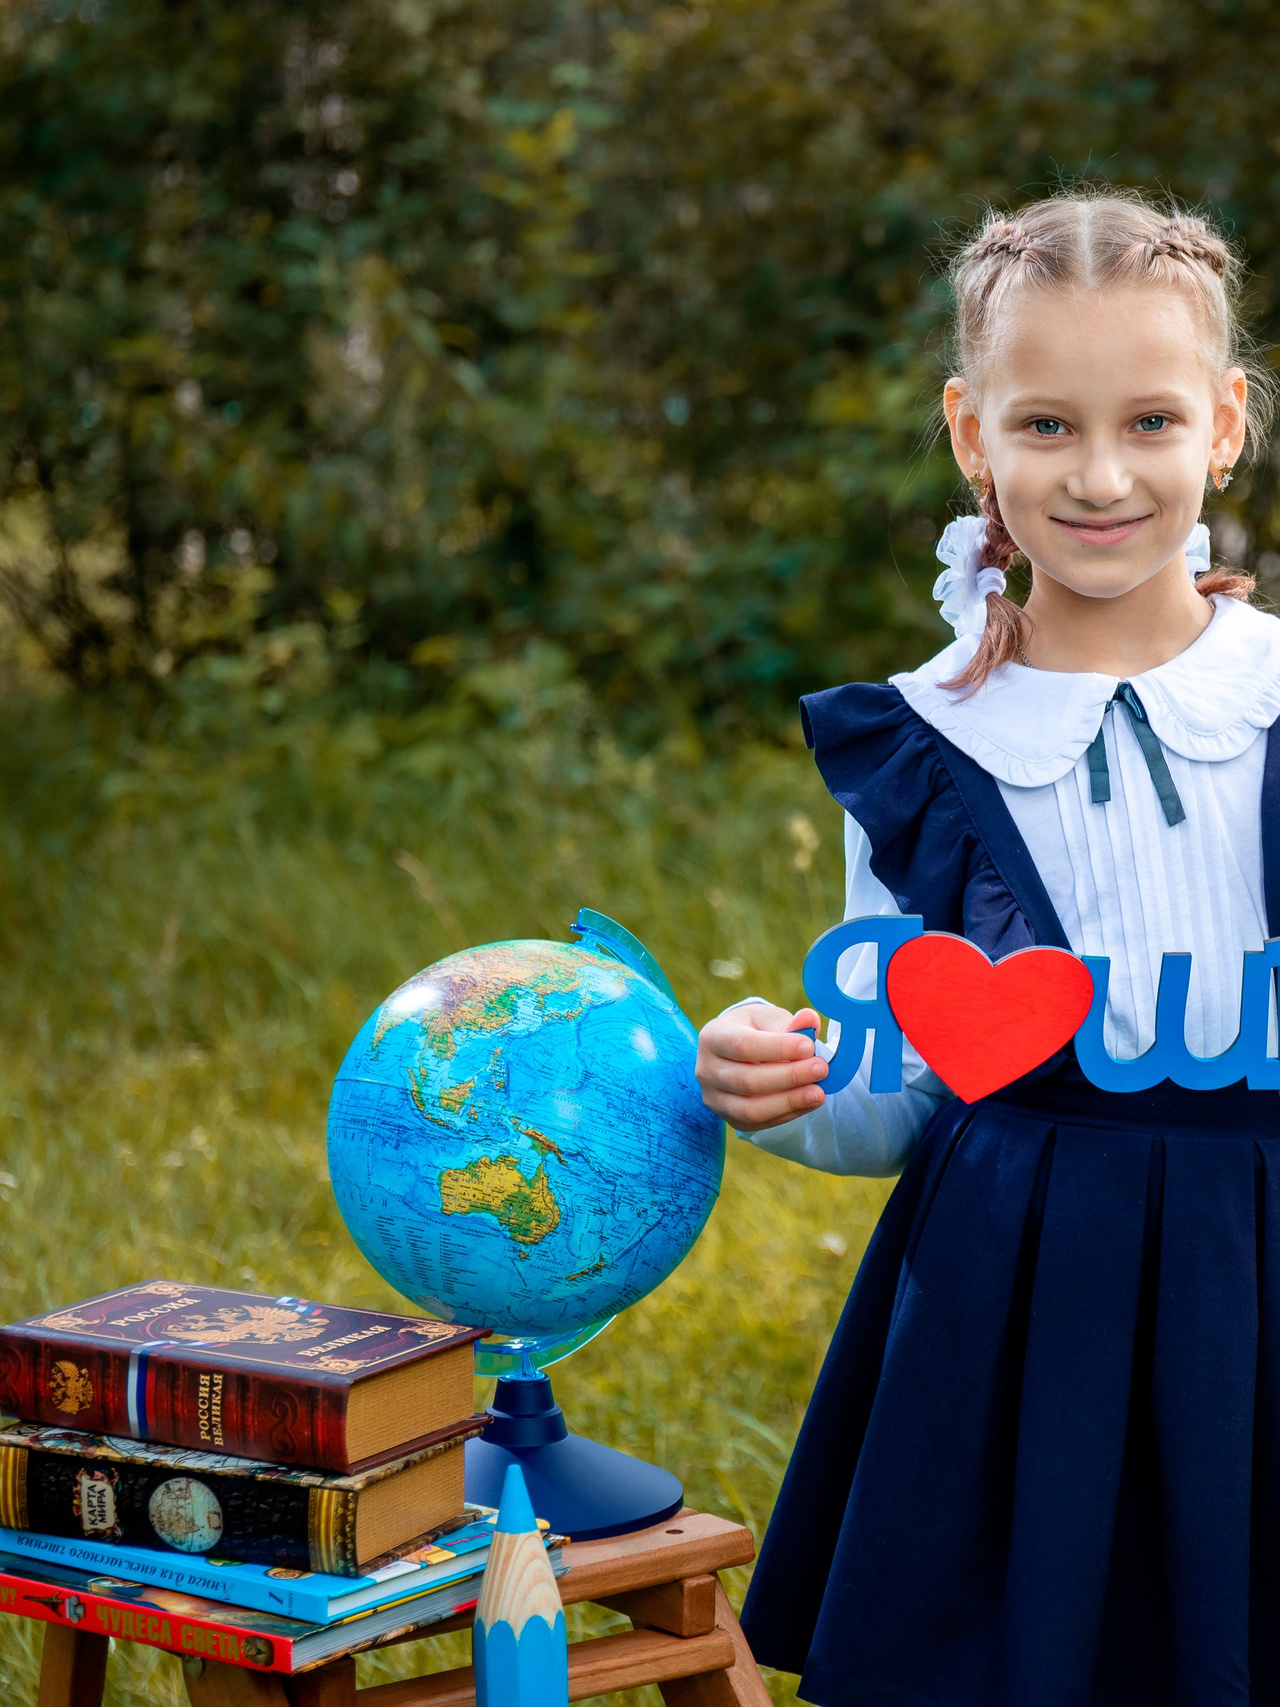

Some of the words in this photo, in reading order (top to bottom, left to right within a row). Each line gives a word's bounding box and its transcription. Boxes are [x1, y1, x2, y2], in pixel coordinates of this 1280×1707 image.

[788, 914, 925, 1096] Я
[107, 1297, 202, 1327] РОССИЯ
[296, 1325, 392, 1357] ВЕЛИКАЯ
[198, 1373, 212, 1441] РОССИЯ
[211, 1373, 225, 1447] ВЕЛИКАЯ
[86, 1484, 99, 1526] КАРТА
[97, 1488, 108, 1524] МИРА
[96, 1603, 173, 1646] ЧУДЕСА
[180, 1623, 241, 1661] СВЕТА
